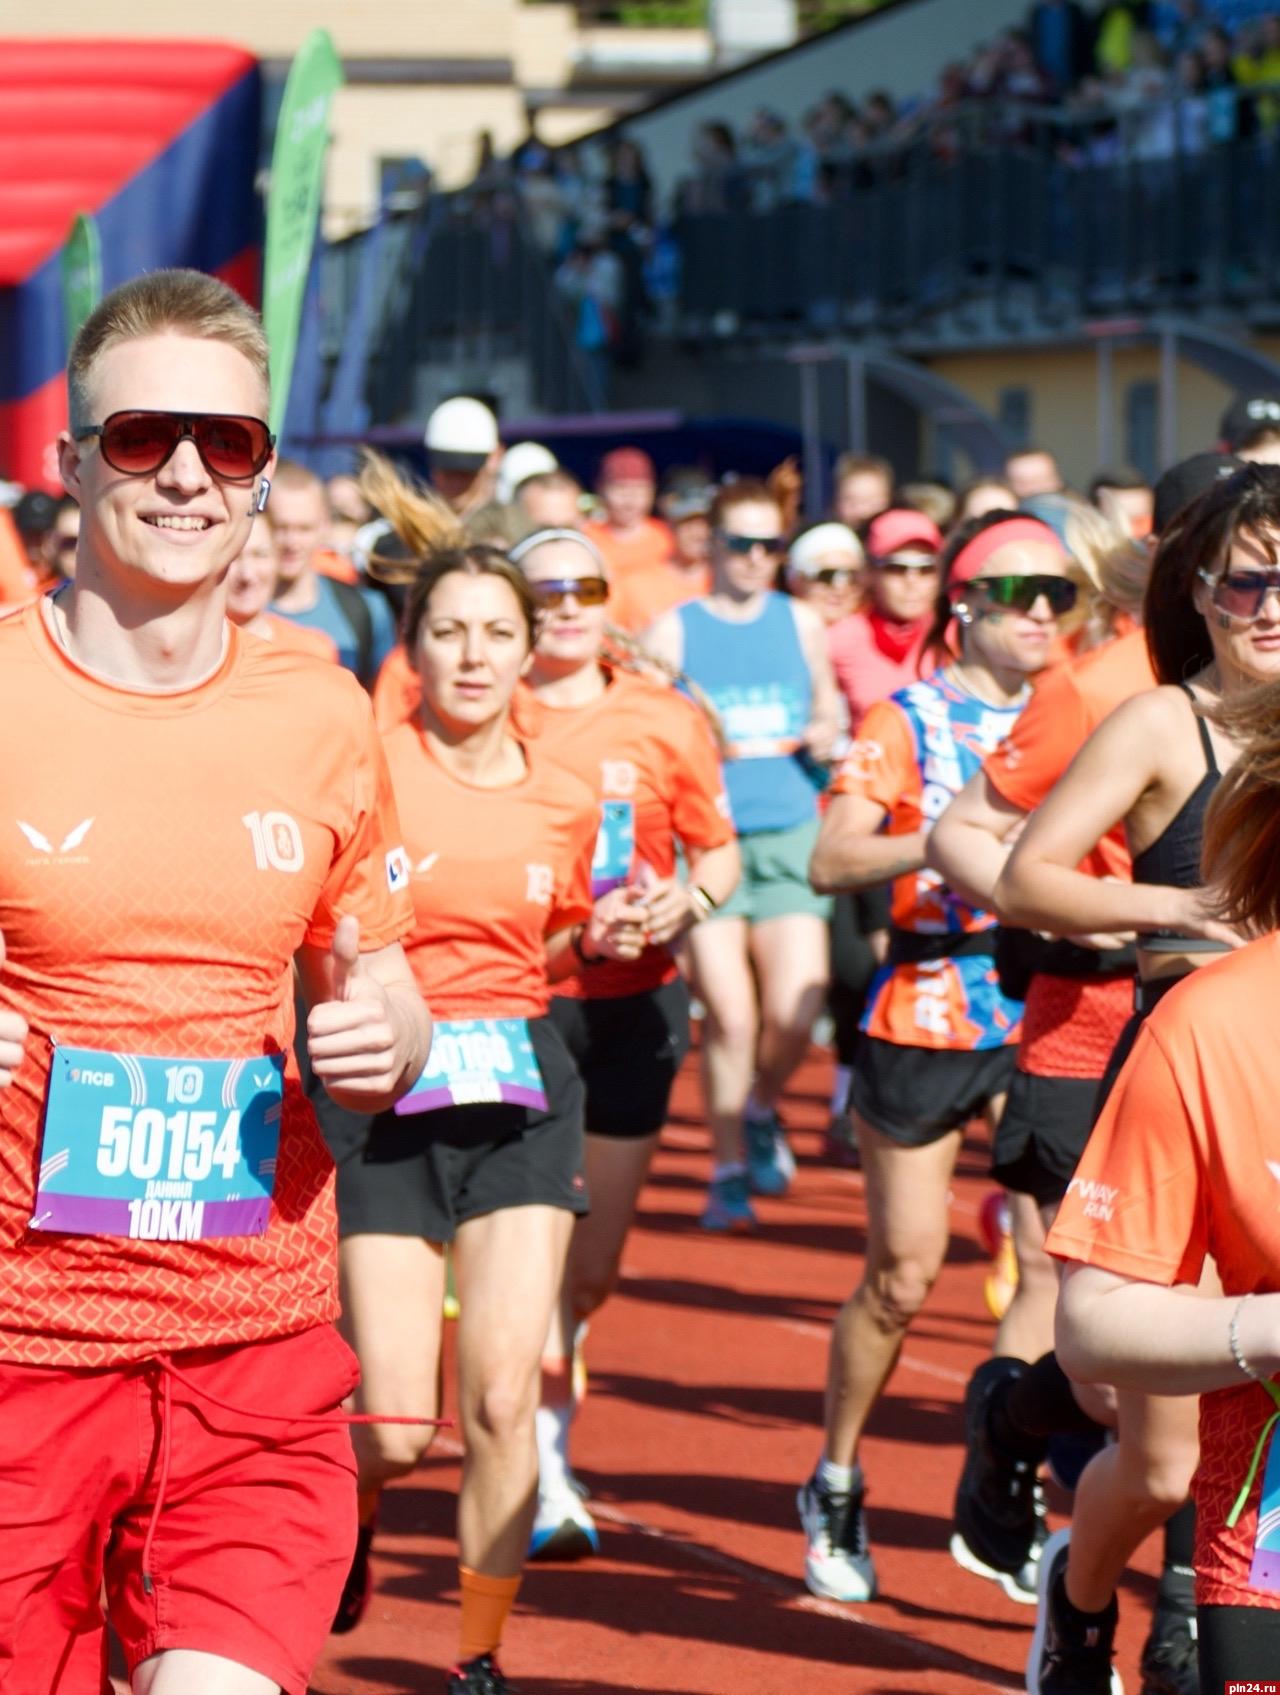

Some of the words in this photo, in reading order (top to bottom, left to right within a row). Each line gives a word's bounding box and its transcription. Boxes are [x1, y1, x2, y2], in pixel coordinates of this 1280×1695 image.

[241, 810, 305, 873] 10
[165, 1066, 204, 1104] 10
[96, 1105, 242, 1181] 50154
[1083, 1200, 1115, 1222] RUN
